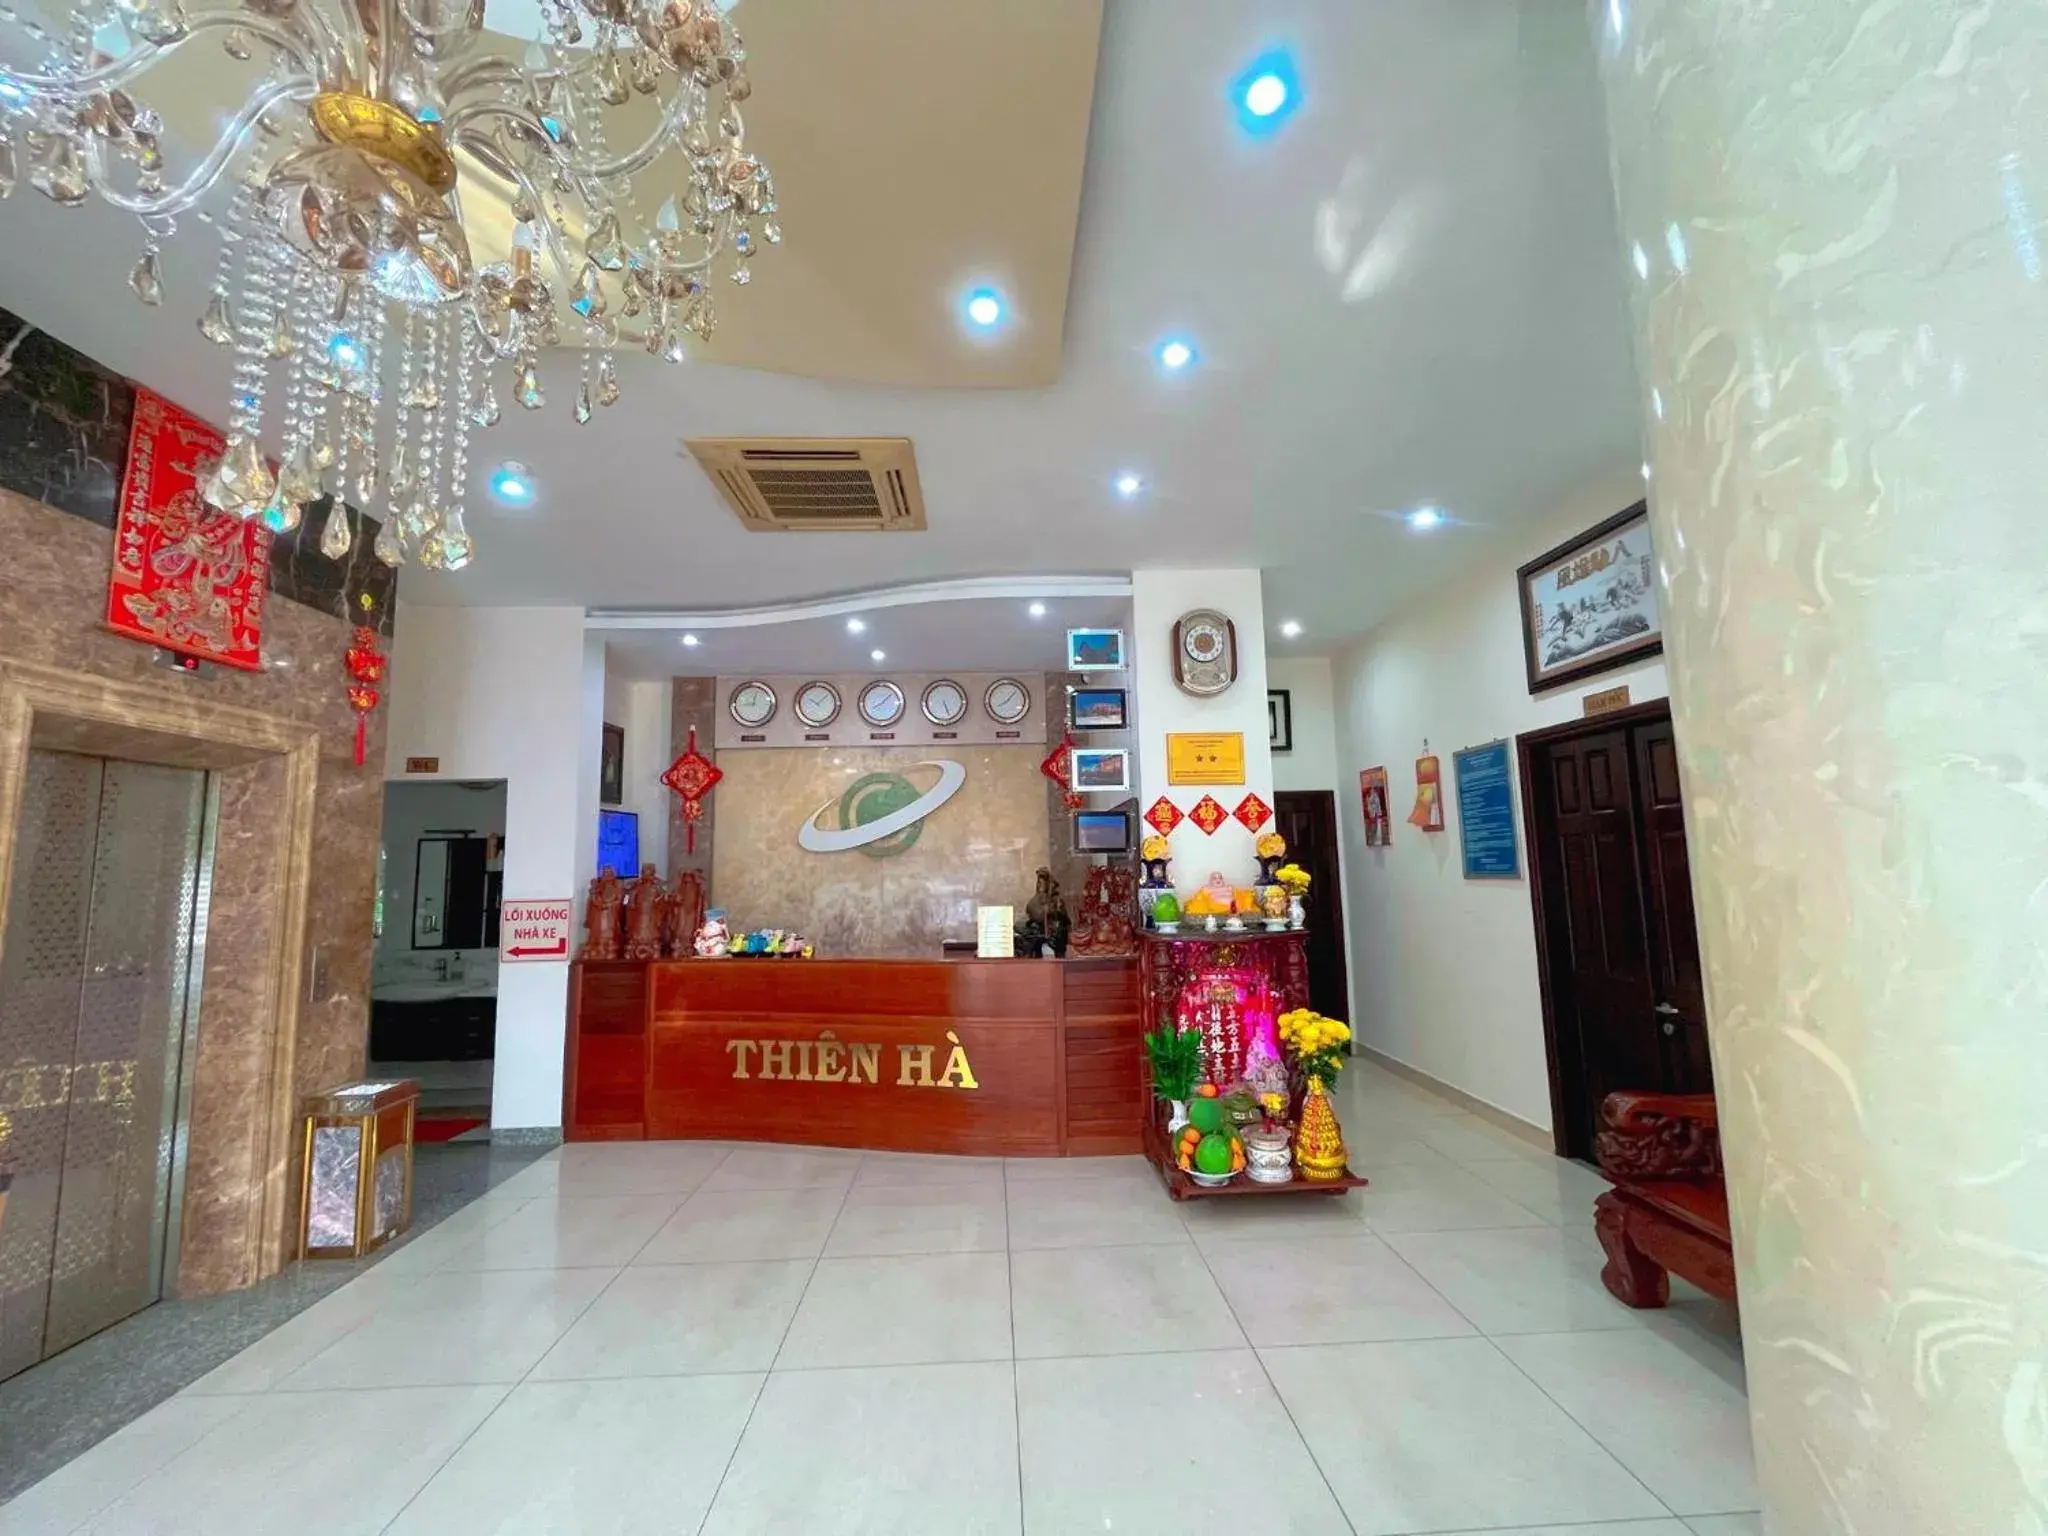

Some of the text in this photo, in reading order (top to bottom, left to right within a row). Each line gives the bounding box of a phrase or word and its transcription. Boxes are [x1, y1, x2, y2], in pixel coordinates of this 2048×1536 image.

[526, 905, 568, 920] XUỐNG
[514, 926, 557, 939] NHÀ XE
[726, 1030, 979, 1089] THIÊN HÀ
